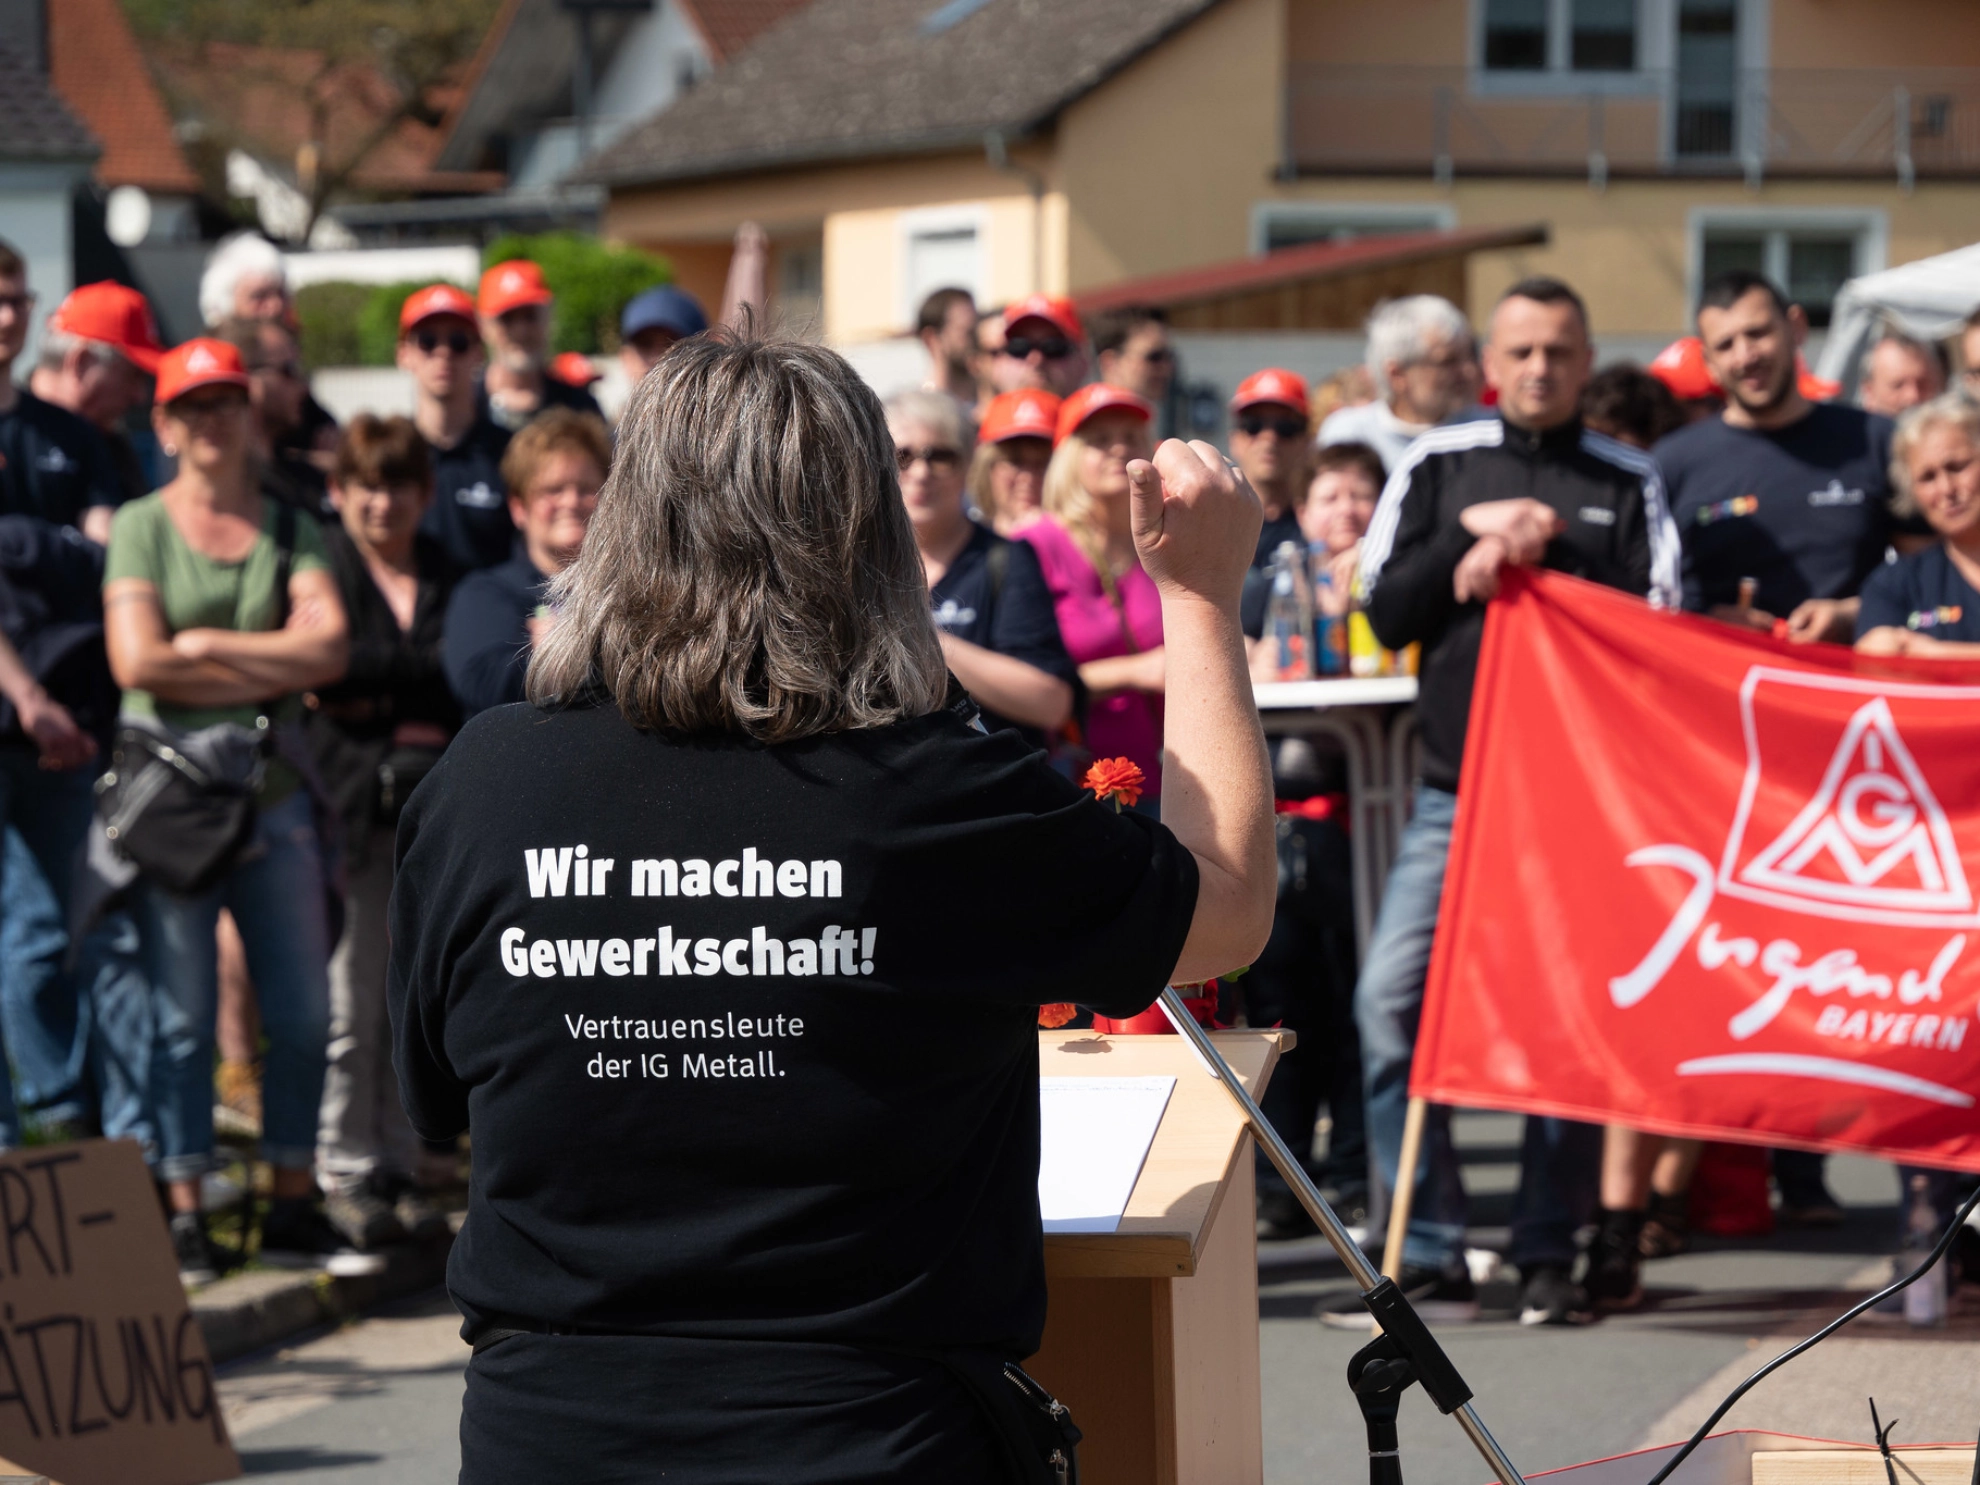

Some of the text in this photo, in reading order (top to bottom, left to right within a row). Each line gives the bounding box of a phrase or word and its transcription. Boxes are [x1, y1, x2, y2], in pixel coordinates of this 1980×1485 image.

[523, 843, 843, 899] Wir machen
[499, 924, 878, 979] Gewerkschaft!
[1608, 843, 1967, 1041] Jugend
[564, 1011, 804, 1040] Vertrauensleute
[1814, 1003, 1969, 1052] BAYERN
[586, 1050, 786, 1079] der IG Metall.
